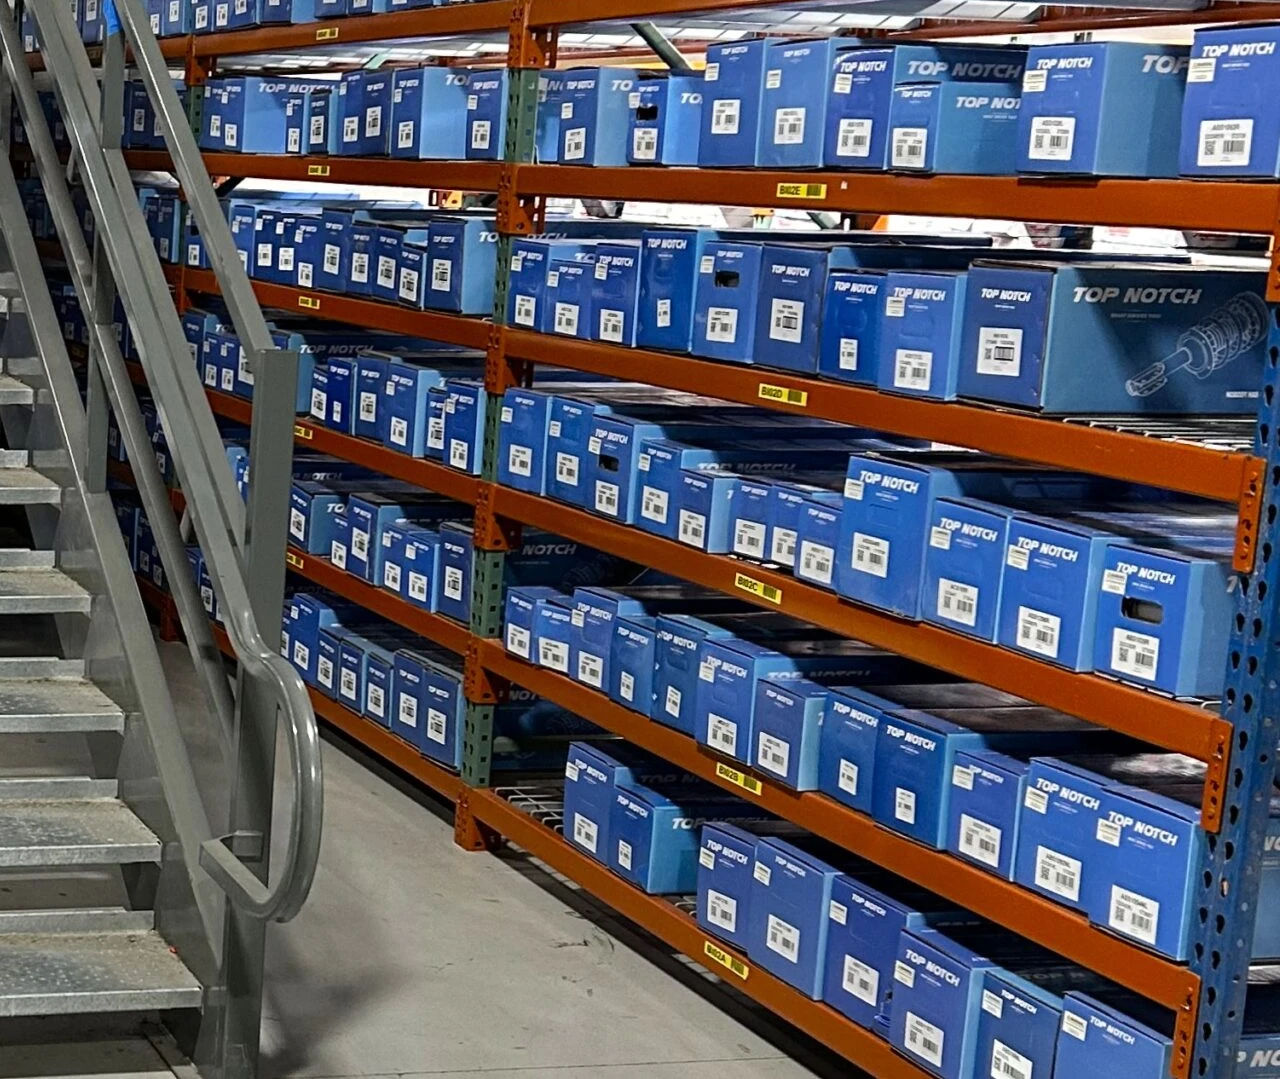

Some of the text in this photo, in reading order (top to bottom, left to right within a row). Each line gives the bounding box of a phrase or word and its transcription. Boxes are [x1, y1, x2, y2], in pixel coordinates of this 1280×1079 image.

[1203, 42, 1275, 57] TOP NOTCH
[840, 61, 886, 72] TOP NOTCH
[908, 61, 1021, 78] TOP NOTCH
[1037, 57, 1092, 69] TOP NOTCH
[1142, 55, 1189, 73] TOP
[259, 83, 286, 92] TOP
[611, 80, 633, 90] TO
[681, 93, 702, 103] TO
[956, 97, 1021, 109] TOP NOT
[648, 239, 686, 249] TOP NOTCH
[528, 252, 543, 261] NOTCH
[599, 256, 633, 267] TOP NOTCH
[772, 265, 809, 277] TOP NOTCH
[834, 282, 878, 294] TOP NOTCH
[894, 287, 946, 301] TOP NOTCH
[982, 288, 1031, 302] TOP NOTCH
[1074, 287, 1202, 304] TOP NOTCH
[300, 345, 373, 354] TOP NOTCH
[595, 428, 628, 443] TOP NOTCH
[860, 471, 919, 493] TOP NOTCH
[940, 518, 997, 542] TOP NOTCH
[522, 544, 576, 555] NOTCH
[1018, 537, 1078, 562] TOP NOTCH
[1117, 562, 1175, 584] TOP NOTCH
[577, 602, 612, 621] TOP NOTCH
[618, 627, 648, 645] TOP NOTCH
[660, 631, 696, 651] TOP NOTCH
[707, 656, 747, 678] TOP NOTCH
[833, 702, 878, 727] TOP NOTCH
[886, 725, 936, 751] TOP NOTCH
[575, 760, 607, 782] TOP NOTCH
[969, 765, 1003, 784] TOP NOTCH
[1036, 778, 1100, 810] TOP NOTCH
[617, 795, 648, 818] TOP NOTCH
[1108, 812, 1177, 846] TOP NOTCH
[707, 839, 748, 864] TOP NOTCH
[775, 856, 805, 876] TOP NOTCH
[852, 894, 886, 916] TOP NOTCH
[906, 949, 960, 986] TOP NOTCH
[1002, 989, 1037, 1014] TOP NOTCH
[1091, 1016, 1134, 1045] TOP NOTCH
